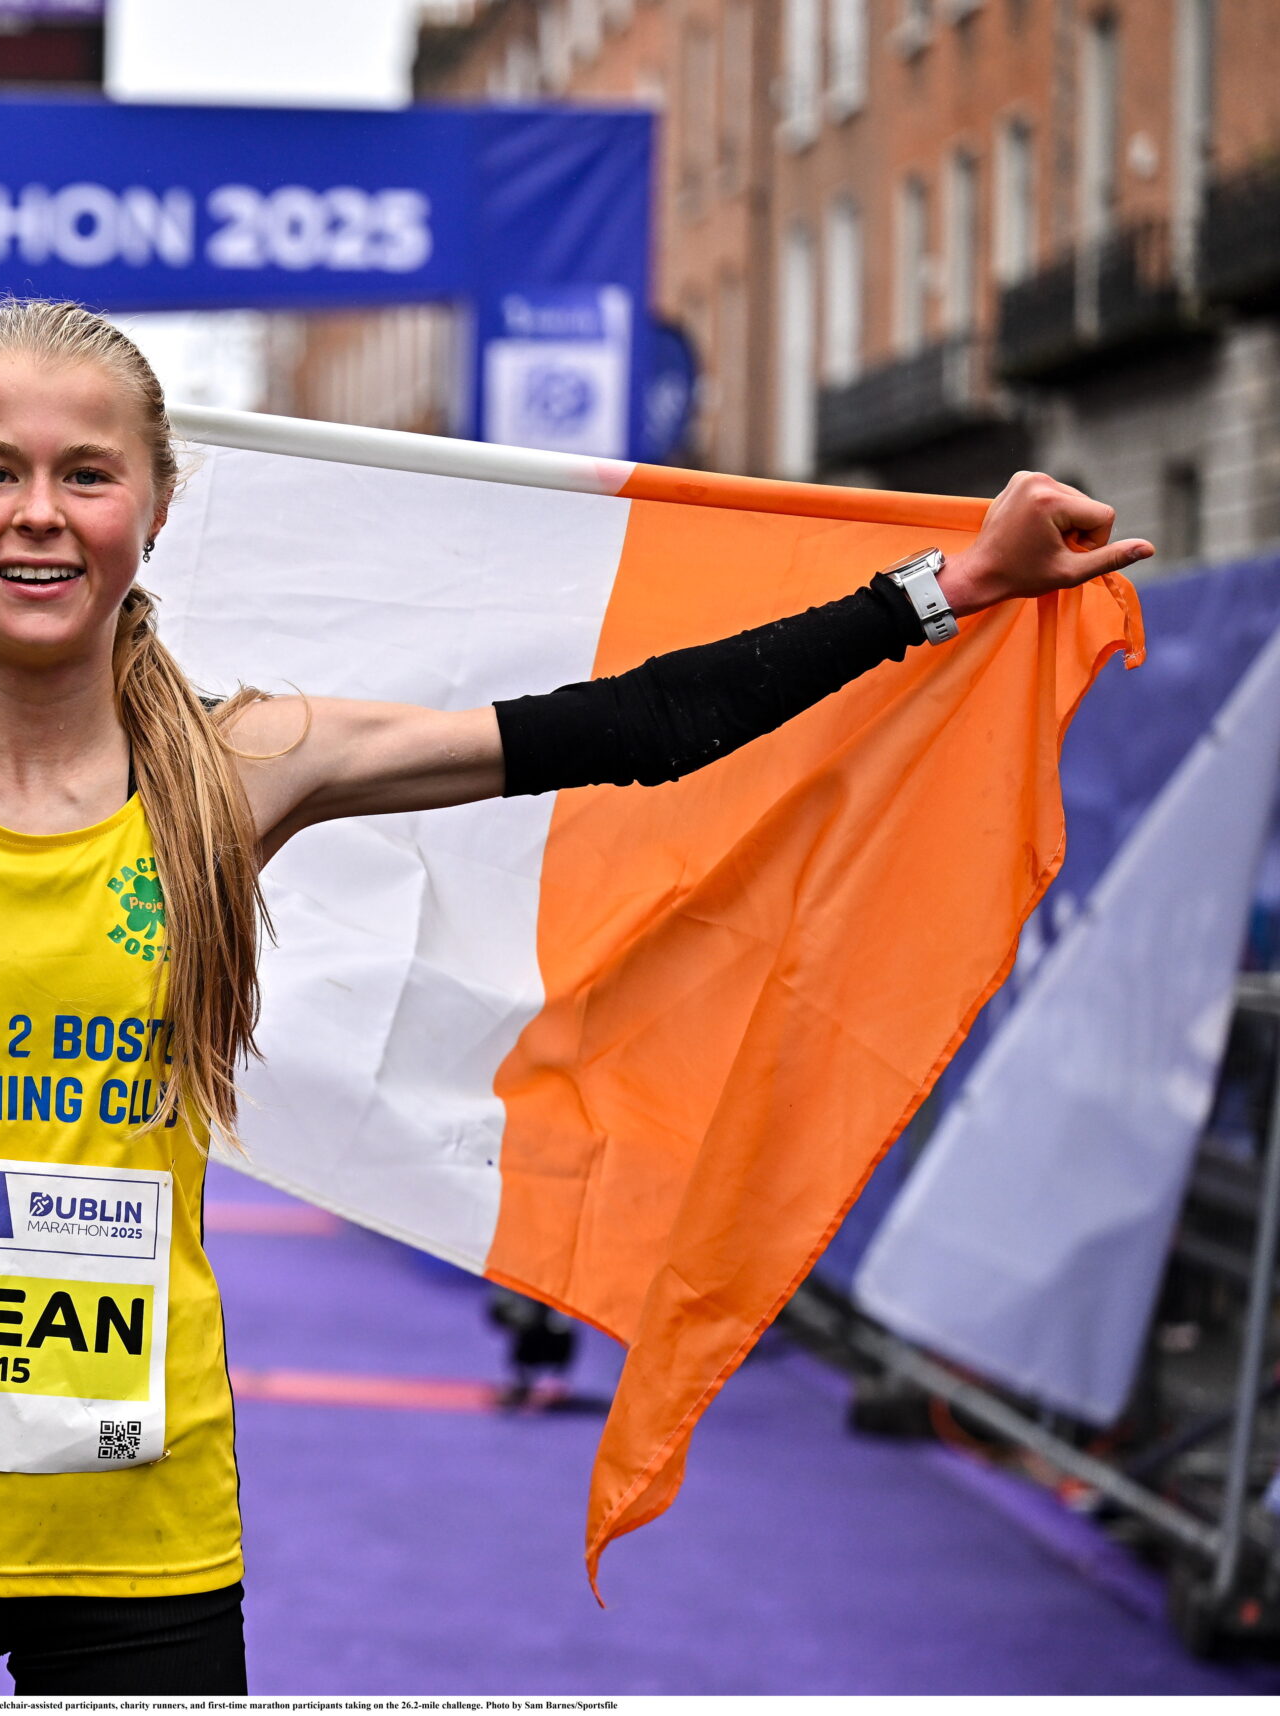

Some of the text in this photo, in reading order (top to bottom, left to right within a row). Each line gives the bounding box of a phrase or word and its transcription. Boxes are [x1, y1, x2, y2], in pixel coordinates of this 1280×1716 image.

[206, 185, 433, 273] 2025
[129, 897, 163, 913] Proje
[8, 1014, 33, 1058] 2
[29, 1191, 142, 1224] DUBLIN
[27, 1220, 143, 1239] MARATHON 2025
